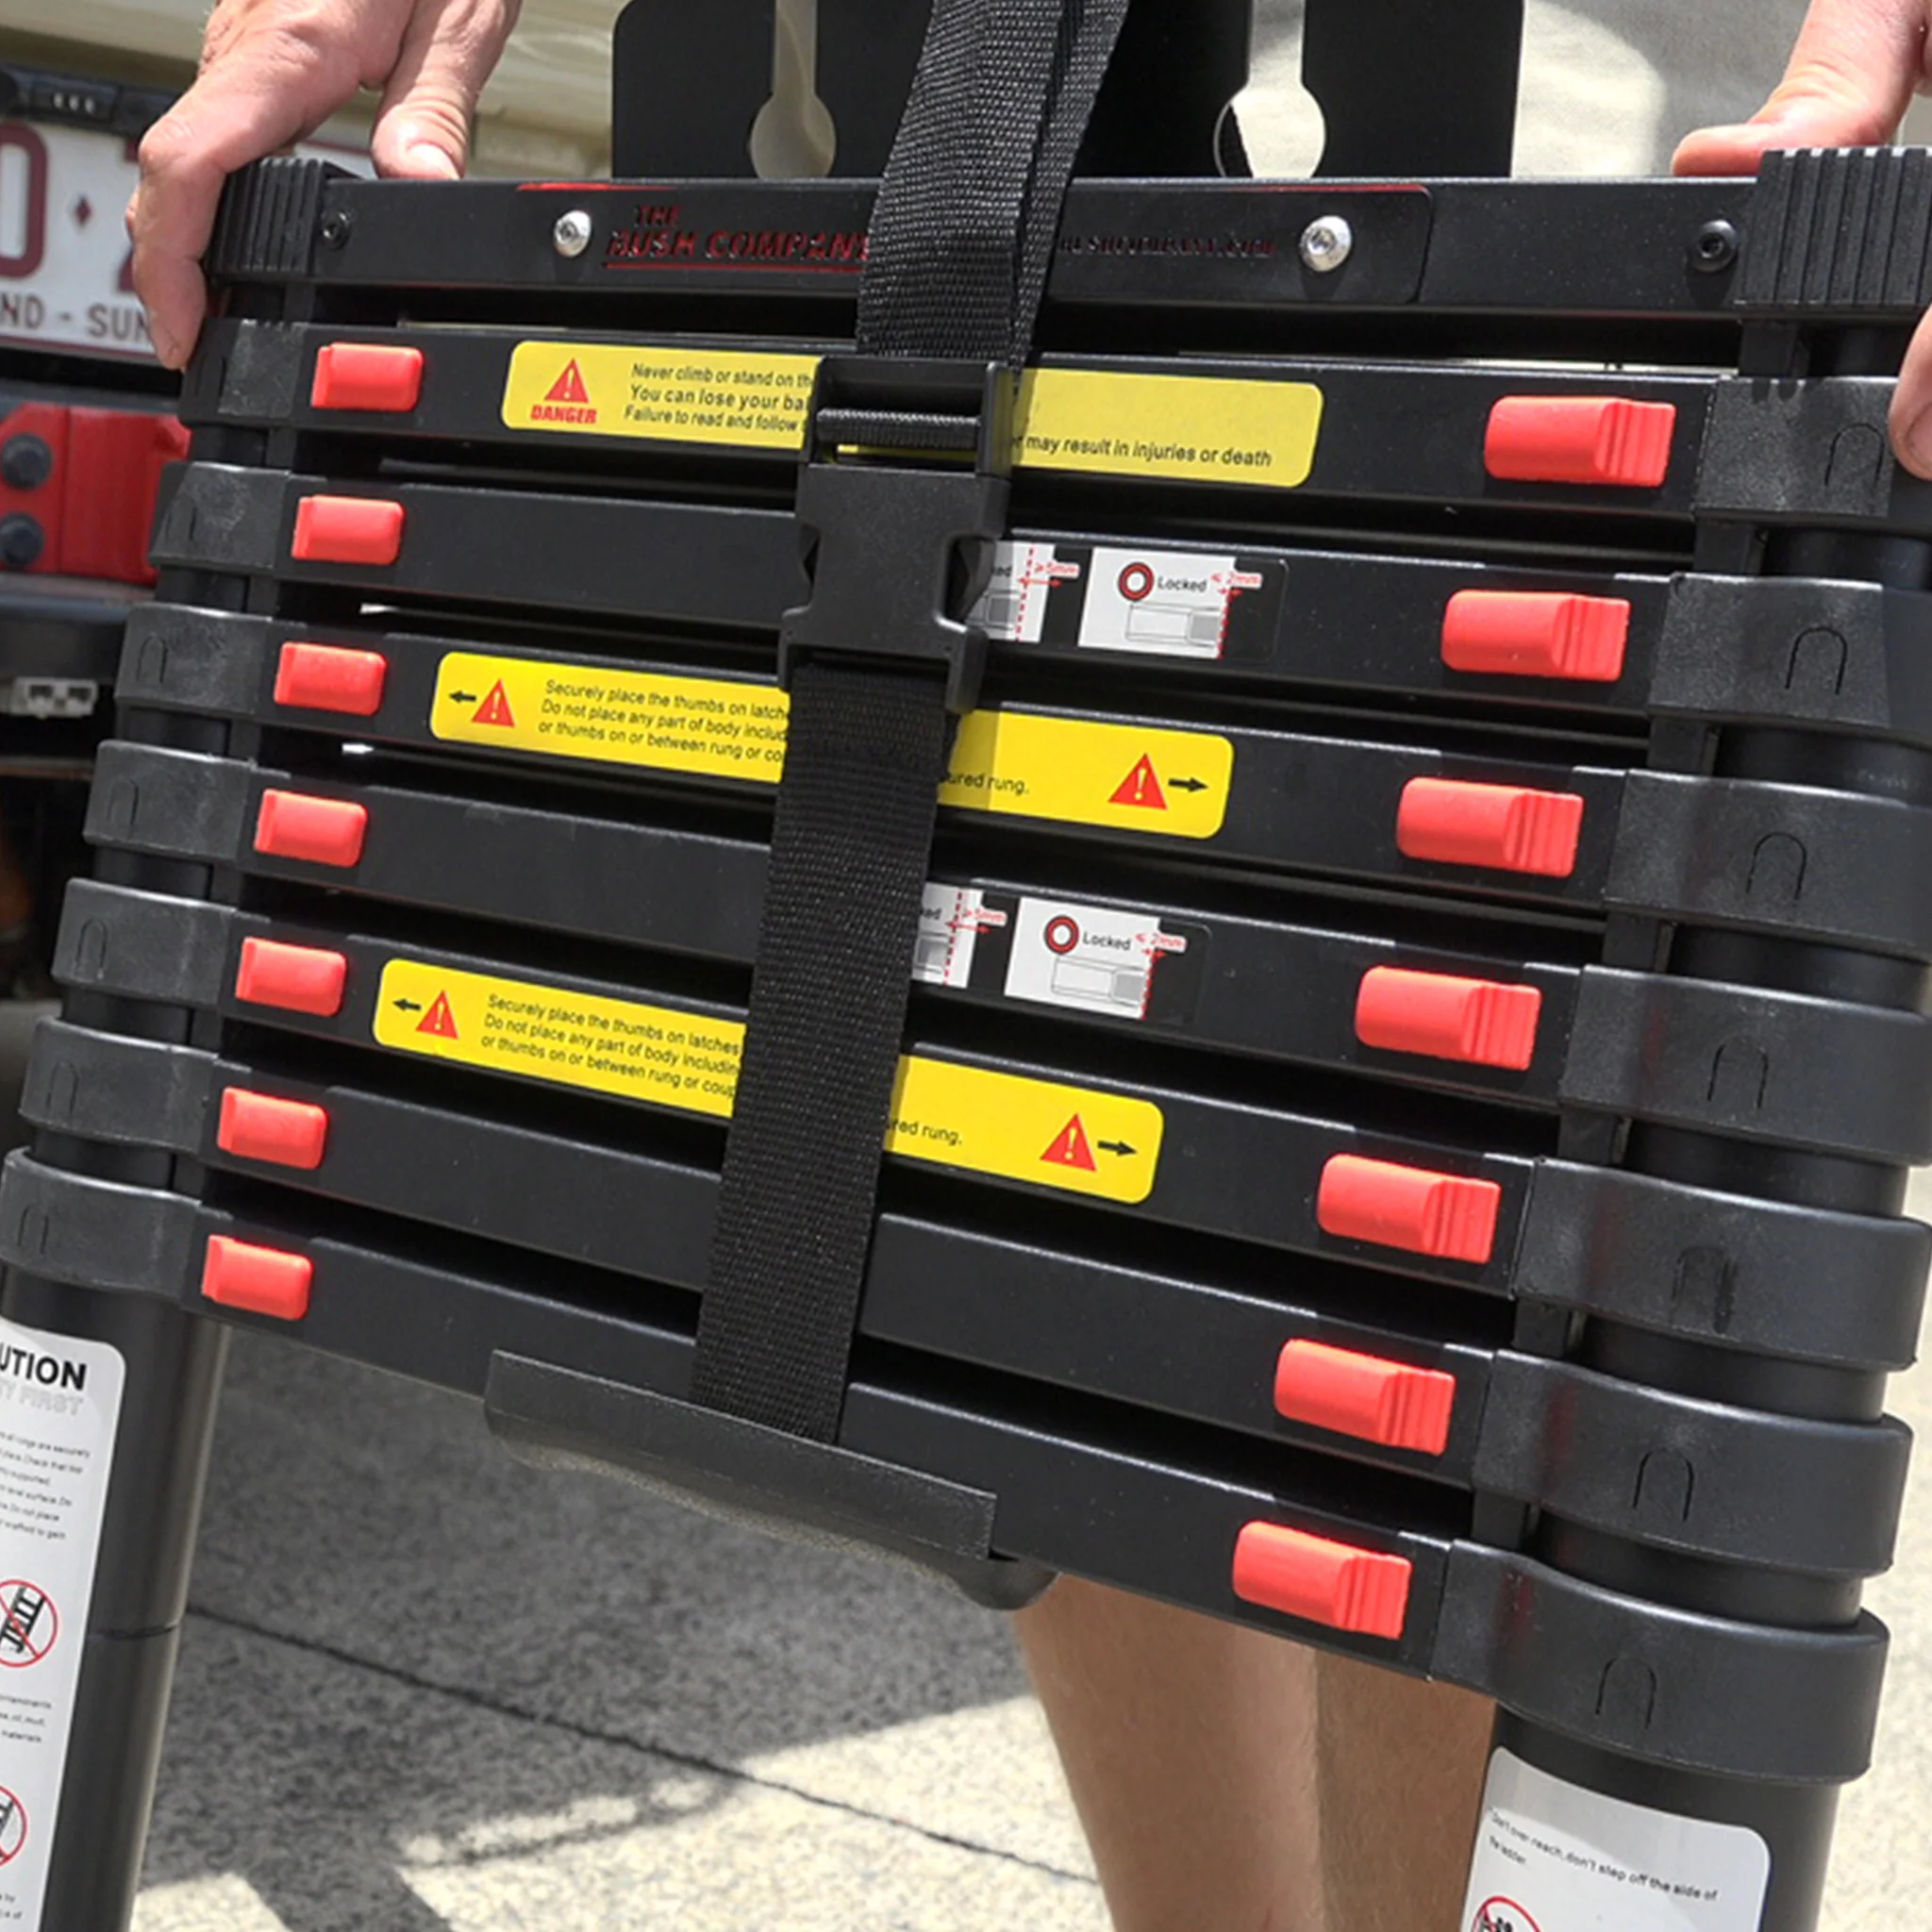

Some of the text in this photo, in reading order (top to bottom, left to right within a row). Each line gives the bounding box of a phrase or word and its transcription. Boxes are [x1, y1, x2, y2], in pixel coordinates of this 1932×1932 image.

[631, 362, 813, 389] Never climb or stand on th
[630, 383, 806, 413] You can lose your ba
[530, 404, 597, 425] DANGER
[624, 404, 798, 433] Failure to read and follow
[1025, 435, 1061, 456] may
[1062, 438, 1111, 456] result
[1113, 439, 1130, 457] in
[1132, 440, 1197, 463] injuries
[1199, 448, 1219, 463] or
[1221, 446, 1273, 467] death
[1157, 575, 1208, 593] Locked
[544, 678, 606, 703] Securely
[606, 687, 646, 705] place
[647, 691, 670, 708] the
[674, 695, 724, 713] thumbs
[728, 702, 747, 716] on
[541, 698, 561, 715] Do
[562, 704, 587, 718] not
[587, 705, 626, 723] place
[627, 711, 657, 729] any
[656, 715, 687, 731] part
[688, 718, 704, 732] of
[705, 719, 741, 740] body
[538, 720, 554, 734] or
[555, 721, 607, 741] thumbs
[608, 729, 627, 742] on
[627, 731, 645, 745] or
[646, 732, 707, 753] between
[708, 741, 743, 760] rung
[744, 746, 762, 759] or
[986, 775, 1030, 797] rung.
[1081, 930, 1132, 952] Locked
[483, 1012, 504, 1030] Do
[506, 1019, 528, 1035] not
[528, 1024, 567, 1043] place
[568, 1032, 594, 1051] any
[594, 1037, 625, 1055] part
[626, 1042, 643, 1058] of
[643, 1045, 680, 1068] body
[487, 992, 741, 1058] Securely place the thumbs on latches
[480, 1035, 496, 1048] or
[497, 1036, 546, 1059] thumbs
[548, 1048, 567, 1062] on
[568, 1052, 585, 1066] or
[586, 1053, 647, 1078] between
[647, 1068, 682, 1090] rung
[682, 1076, 699, 1090] or
[921, 1124, 963, 1147] rung.
[1598, 1863, 1626, 1883] step
[1627, 1872, 1649, 1888] off
[1649, 1876, 1671, 1892] the
[1673, 1883, 1701, 1899] side
[1703, 1889, 1718, 1902] of
